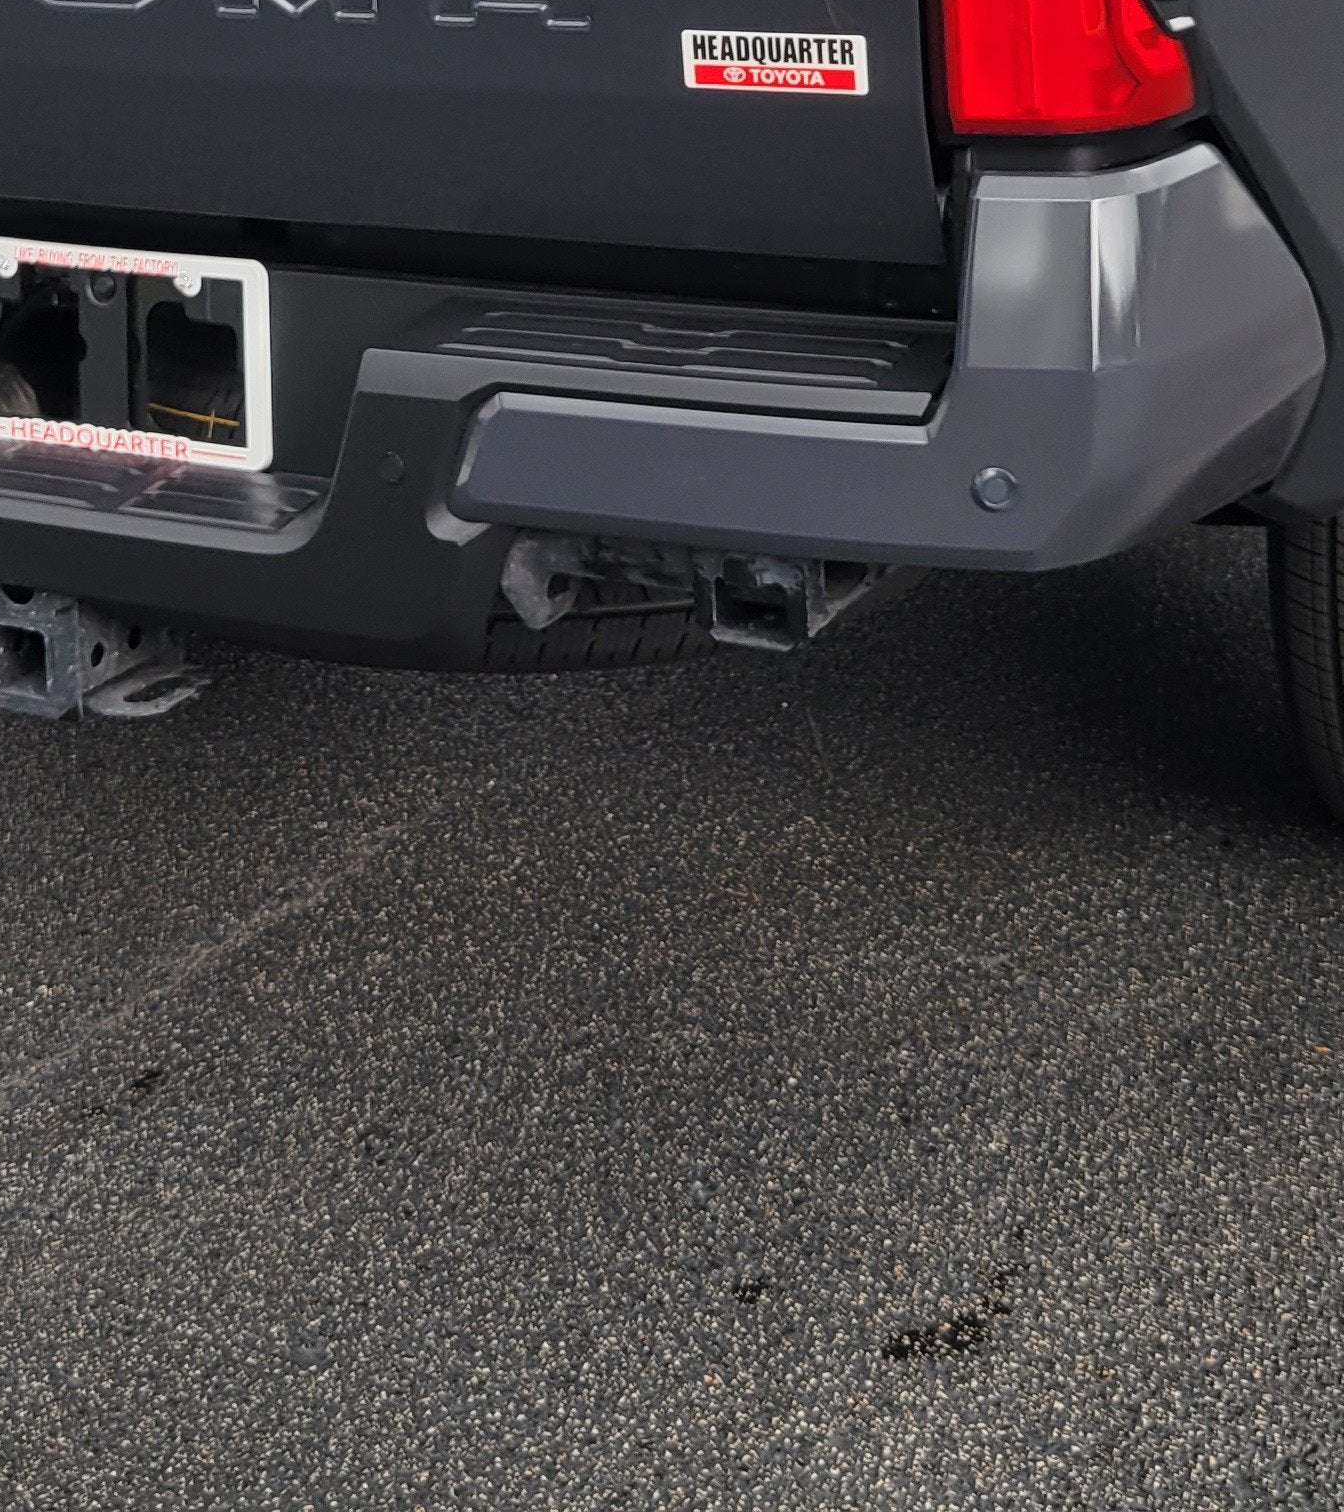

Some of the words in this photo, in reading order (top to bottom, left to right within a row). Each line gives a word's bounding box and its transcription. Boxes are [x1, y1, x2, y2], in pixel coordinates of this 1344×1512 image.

[692, 34, 855, 65] HEADQUARTER
[749, 68, 825, 86] TOYOTA
[78, 252, 106, 269] FROM
[110, 255, 129, 271] THE
[10, 417, 190, 459] HEADQUARTER
